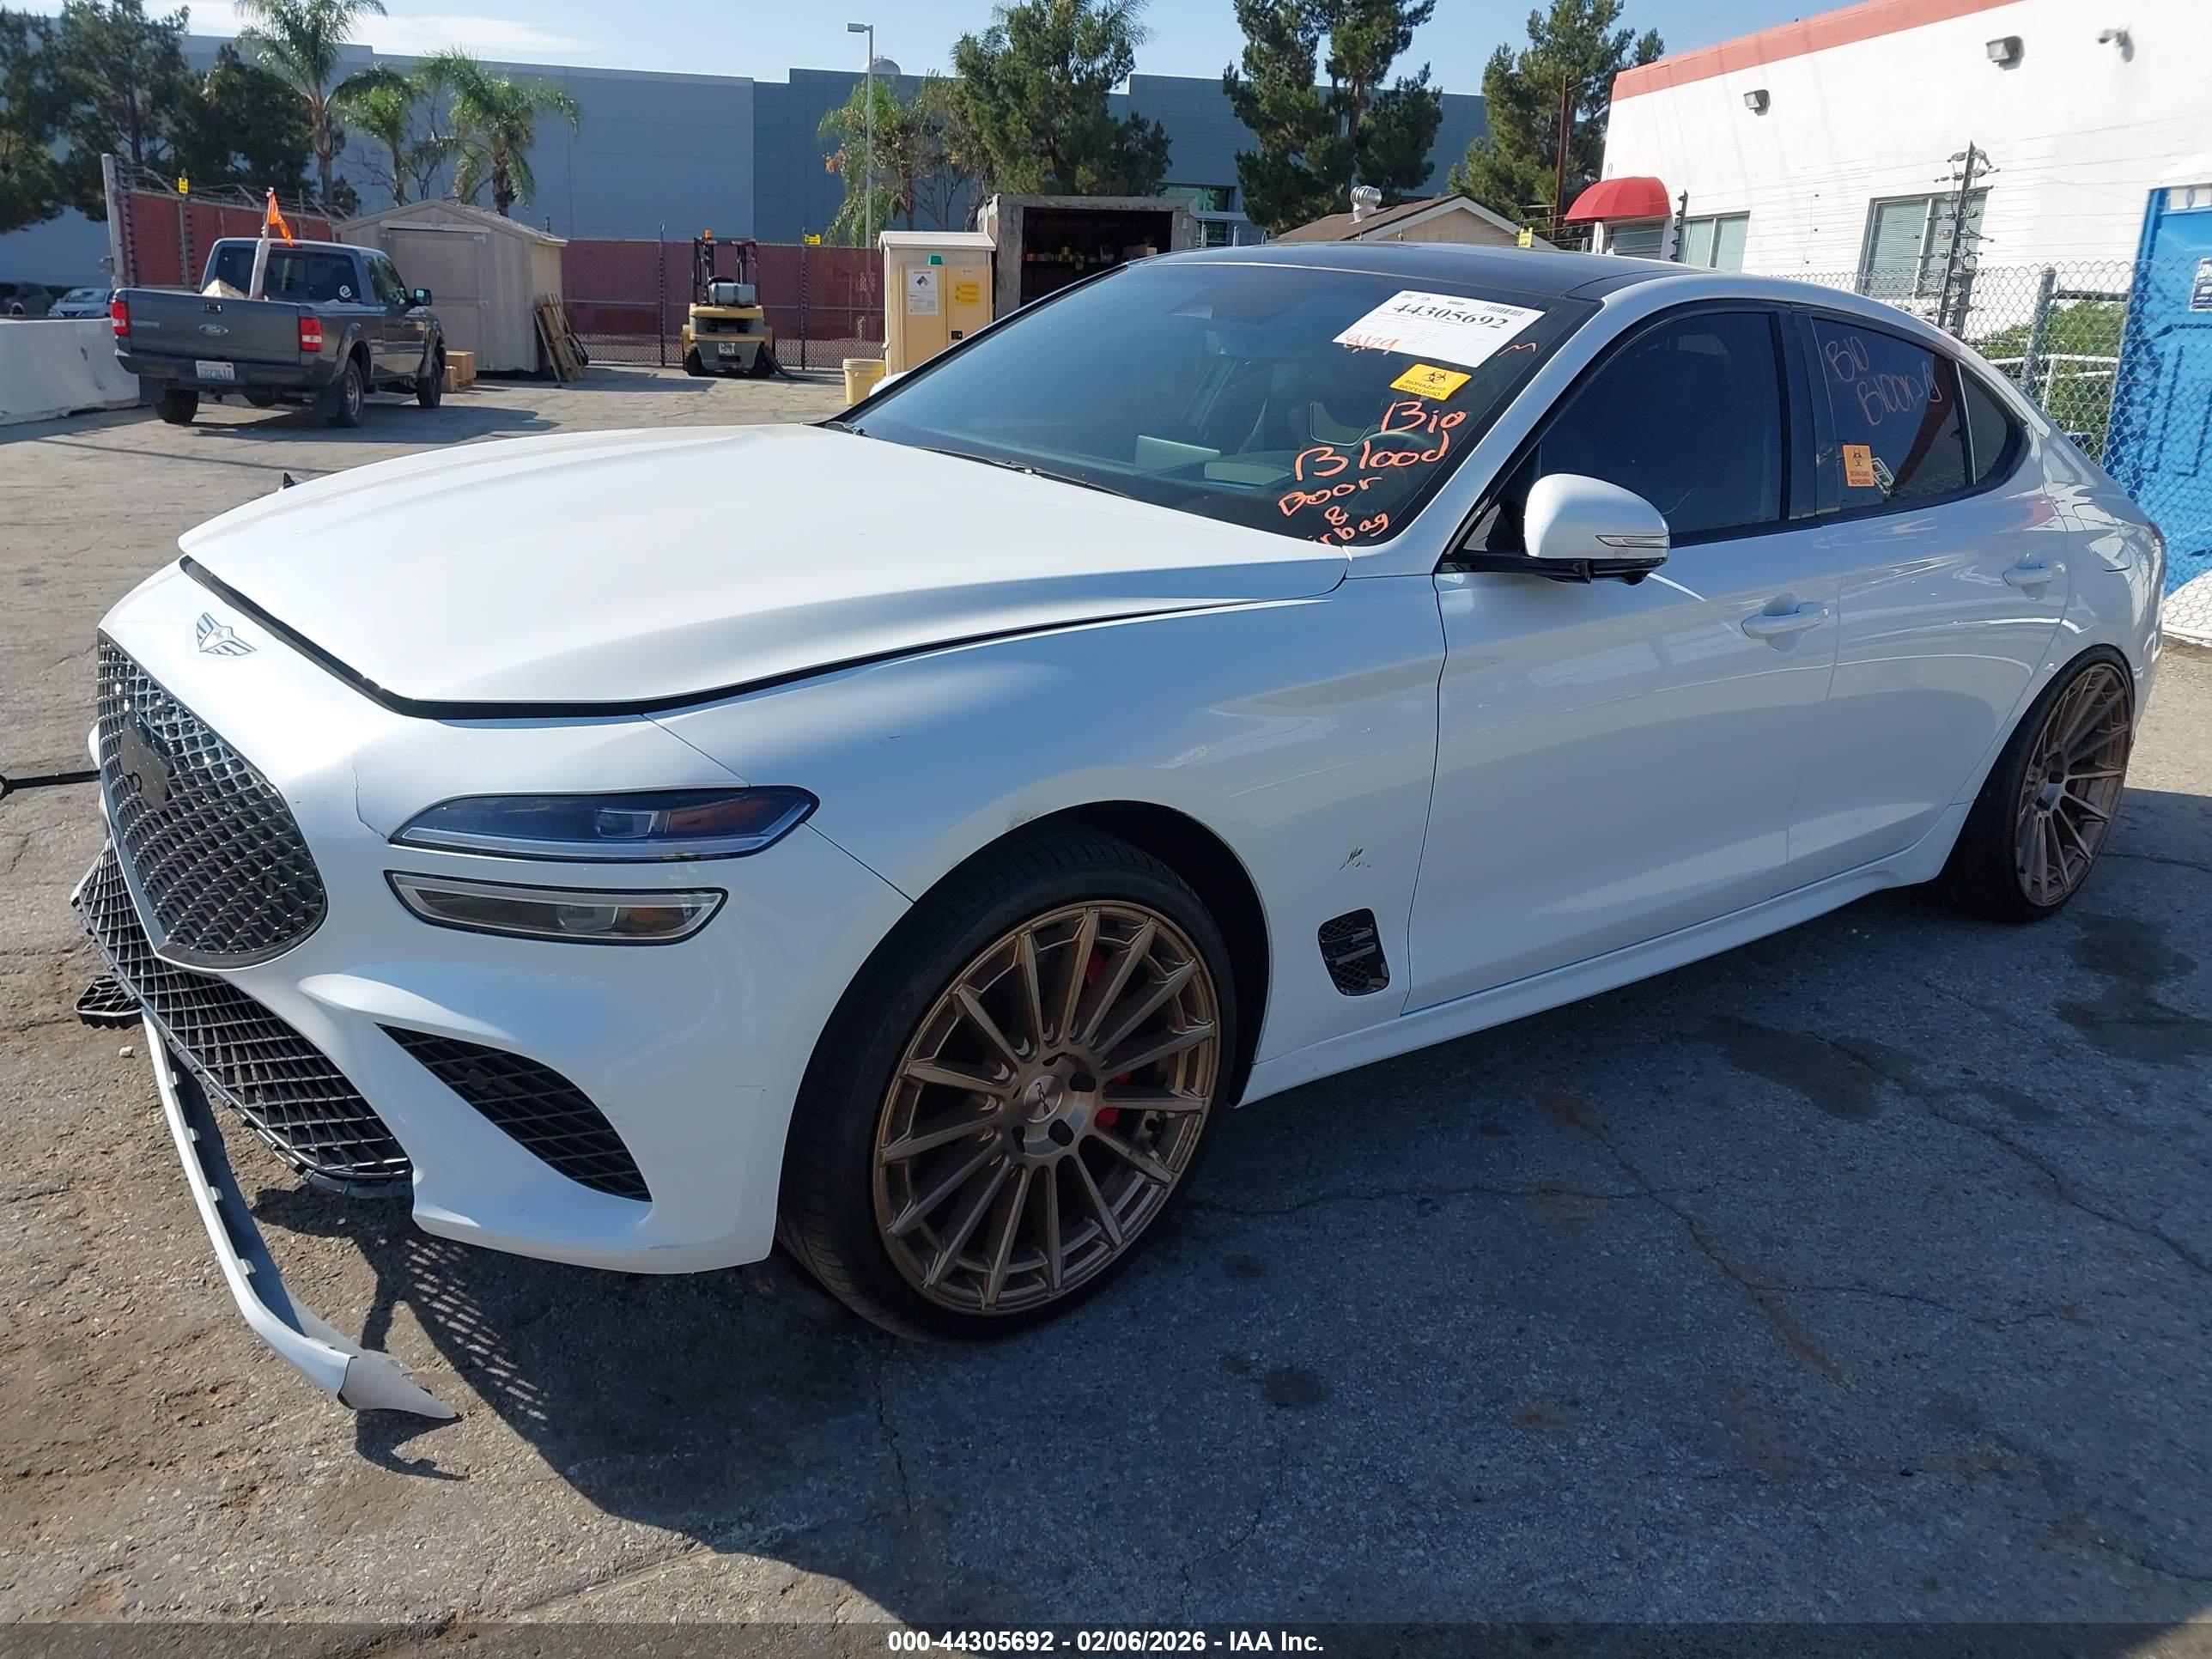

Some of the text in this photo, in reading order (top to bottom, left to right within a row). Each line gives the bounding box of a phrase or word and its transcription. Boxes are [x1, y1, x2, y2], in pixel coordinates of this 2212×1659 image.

[1393, 303, 1509, 330] 44305692
[1404, 379, 1447, 392] BIOHAZARD
[1380, 401, 1467, 434] Bio
[1295, 430, 1449, 481] Blood
[1278, 477, 1382, 516] Door
